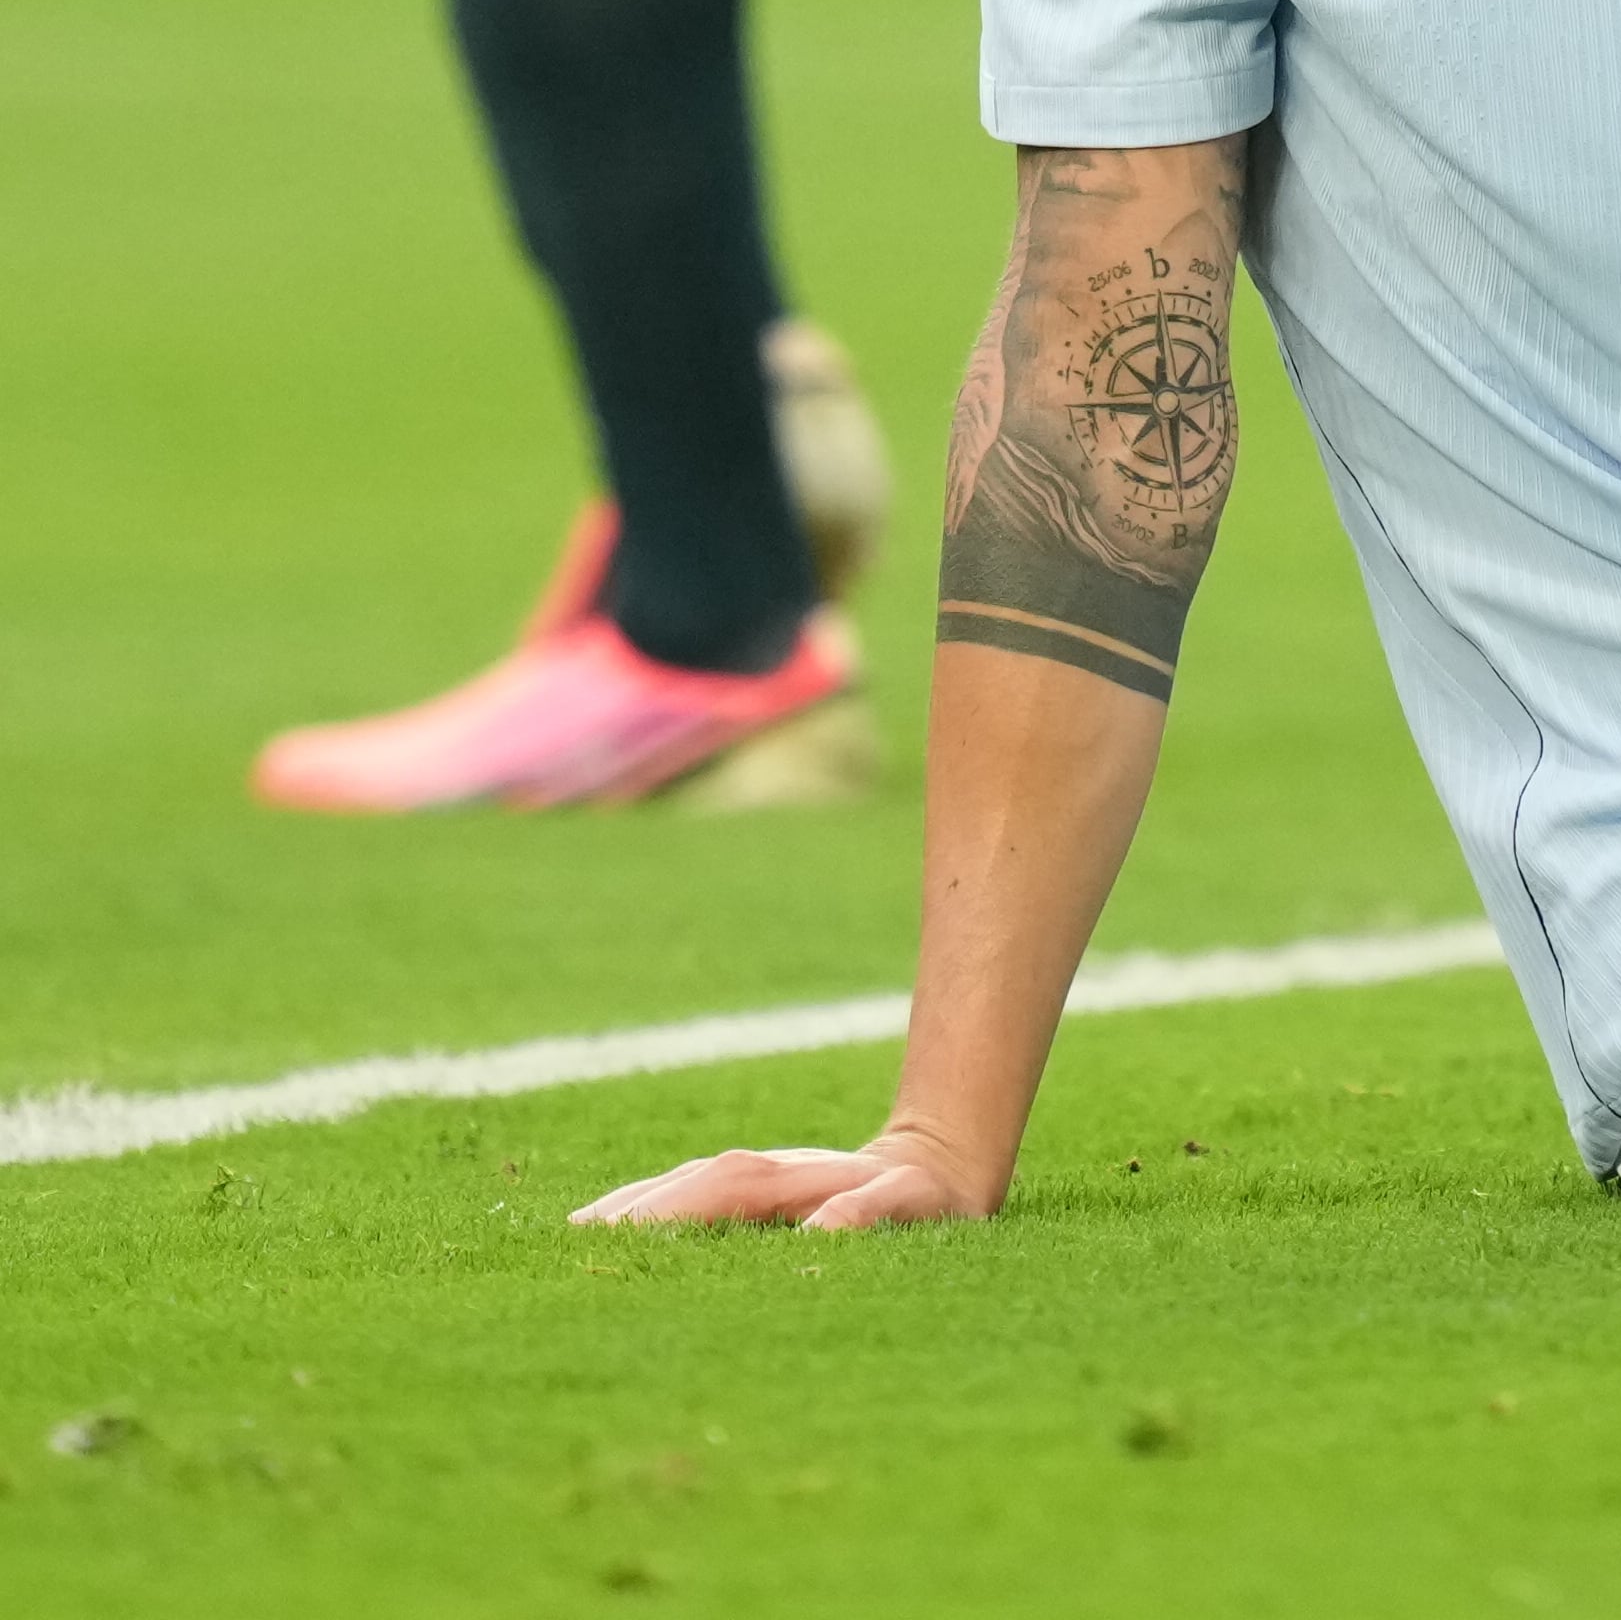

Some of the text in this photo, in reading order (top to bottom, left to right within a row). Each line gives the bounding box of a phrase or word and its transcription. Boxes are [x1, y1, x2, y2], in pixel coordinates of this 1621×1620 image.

[1088, 260, 1132, 292] 25/06
[1144, 247, 1171, 279] b
[1171, 523, 1188, 550] B
